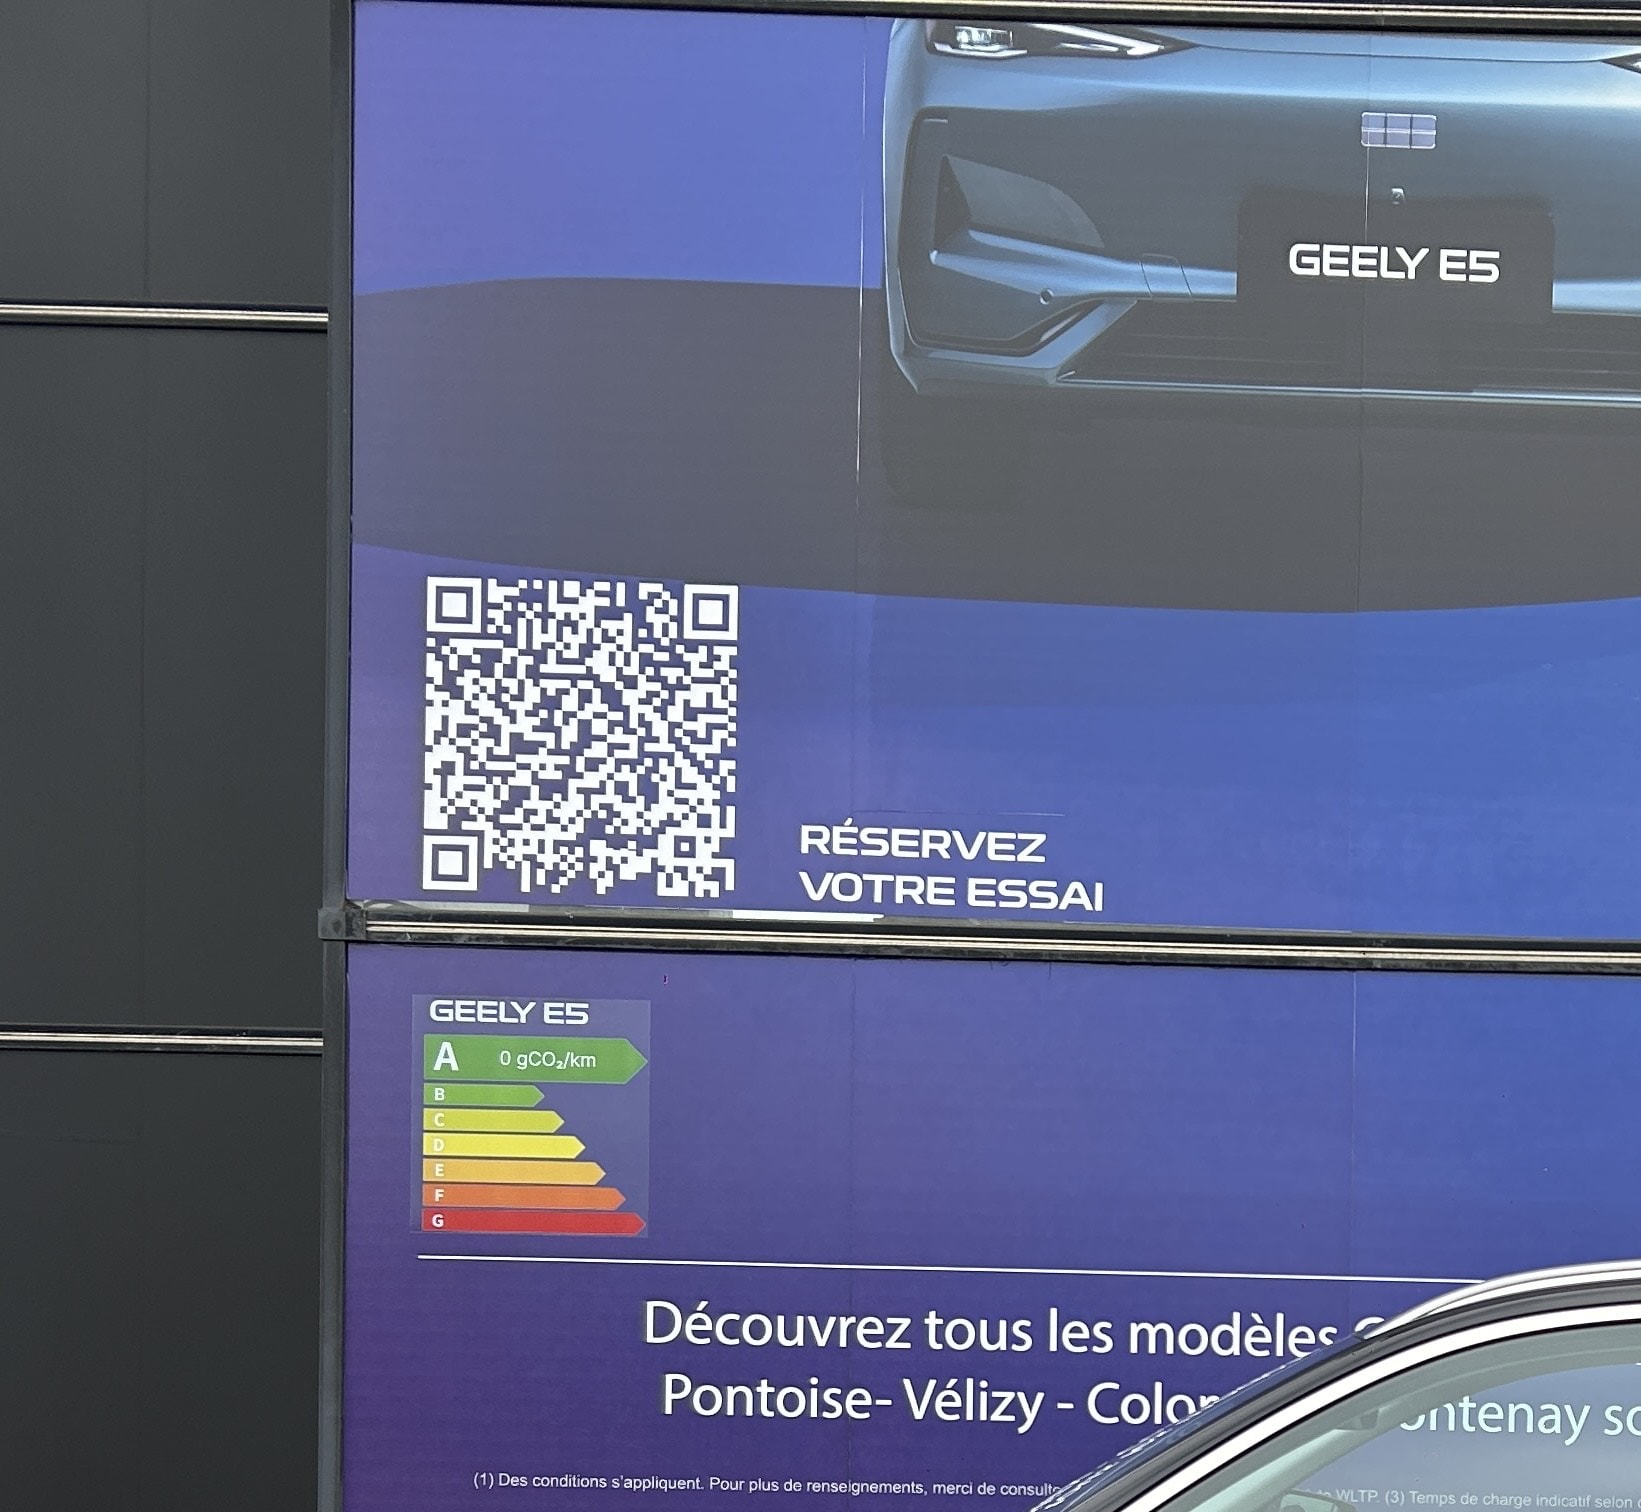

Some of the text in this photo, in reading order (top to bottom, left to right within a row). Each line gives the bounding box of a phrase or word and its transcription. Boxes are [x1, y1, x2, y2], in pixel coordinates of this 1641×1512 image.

[1289, 243, 1500, 283] GEELY E5
[800, 818, 1047, 863] RÉSERVEZ
[799, 871, 1104, 911] VOTRE ESSAI
[429, 1000, 589, 1025] GEELY E5
[433, 1041, 459, 1071] A
[499, 1051, 511, 1066] 0
[434, 1088, 445, 1101] B
[433, 1113, 445, 1127] C
[433, 1138, 444, 1152] D
[435, 1163, 444, 1176] E
[435, 1188, 444, 1201] F
[431, 1213, 444, 1228] G
[645, 1300, 912, 1348] Découvrez
[925, 1310, 1033, 1352] tous
[1049, 1307, 1113, 1354] les
[1130, 1311, 1338, 1357] modèles
[903, 1377, 1045, 1434] Vélizy
[473, 1472, 494, 1489] (1)
[498, 1473, 527, 1487] Des
[532, 1473, 608, 1489] conditions
[709, 1476, 745, 1490] Pour
[749, 1476, 780, 1493] plus
[783, 1478, 802, 1492] de
[806, 1479, 928, 1496] renseignements,
[932, 1481, 973, 1495] merci
[977, 1482, 996, 1495] de
[1385, 1490, 1405, 1506] (3)
[1409, 1490, 1456, 1507] Temps
[1460, 1492, 1478, 1506] de
[1483, 1492, 1532, 1510] charge
[1536, 1493, 1592, 1508] indicatif
[1594, 1496, 1633, 1509] selon
